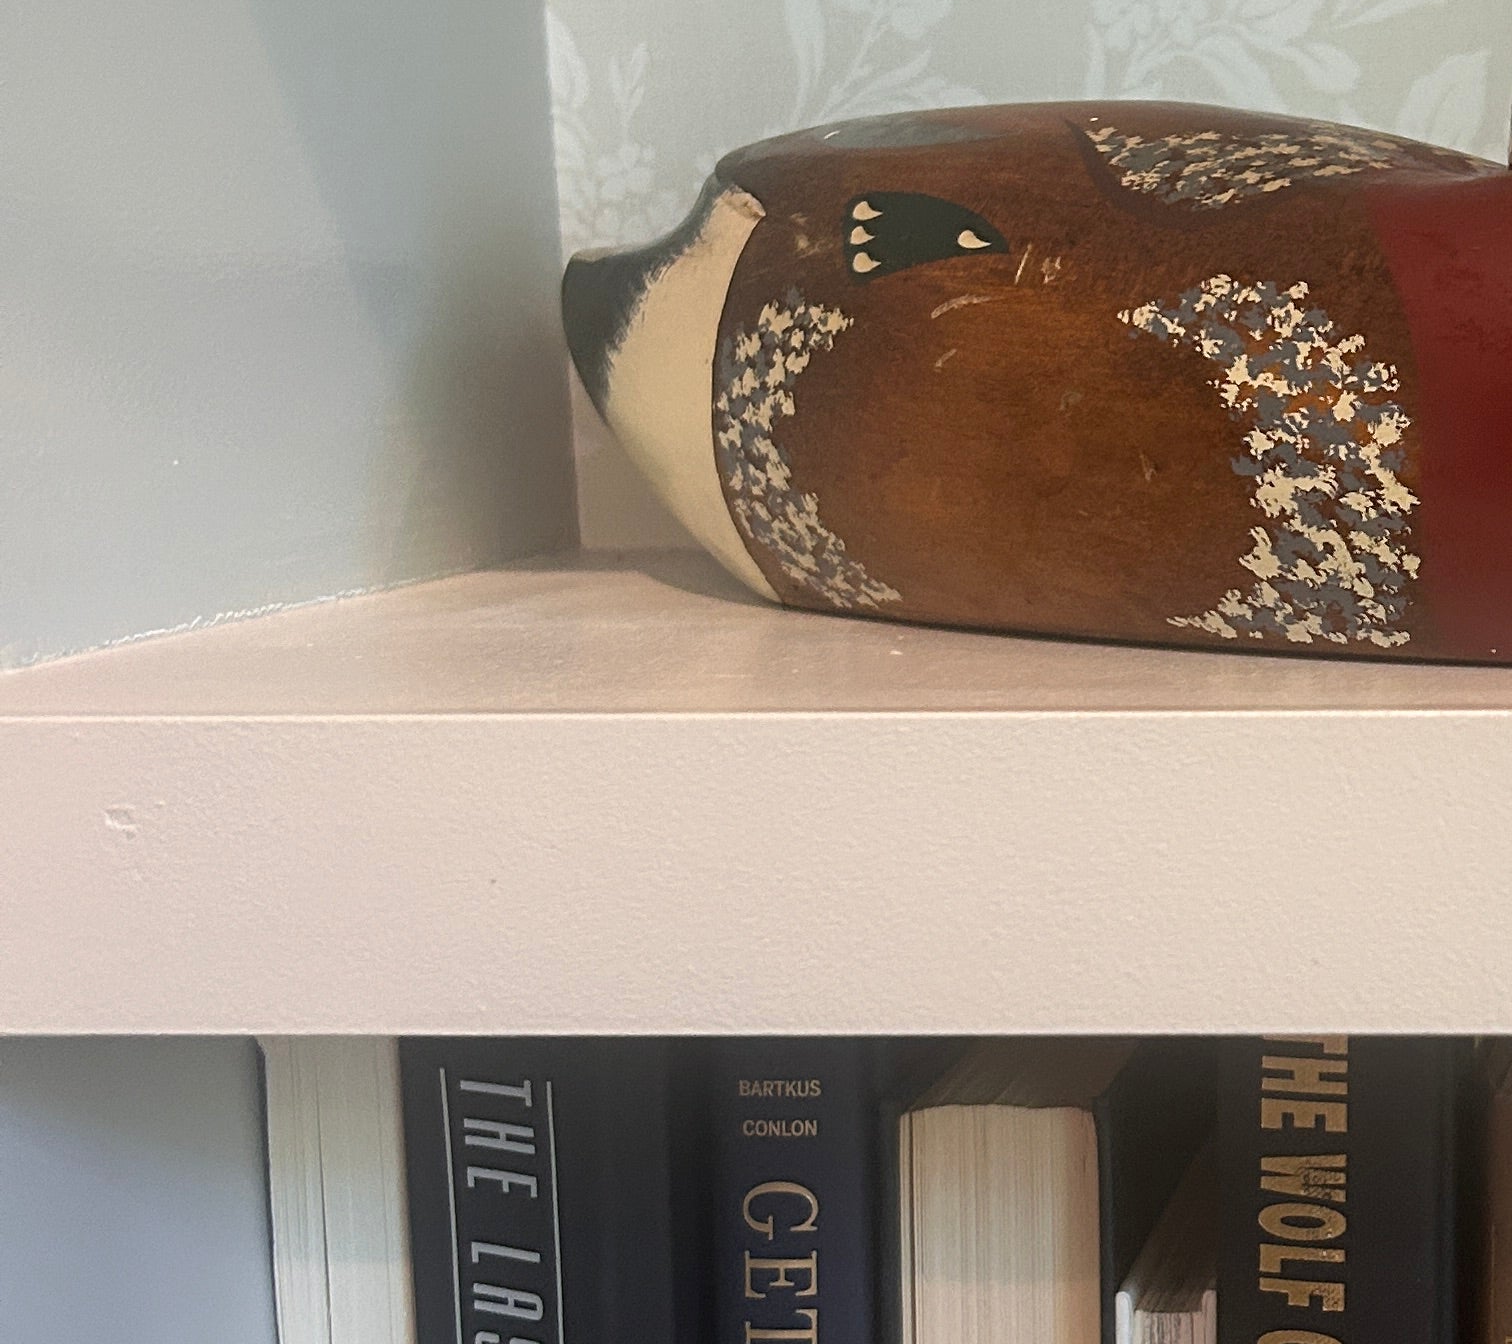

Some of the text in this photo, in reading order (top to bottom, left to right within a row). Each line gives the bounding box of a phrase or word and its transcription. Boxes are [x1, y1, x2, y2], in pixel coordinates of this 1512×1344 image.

[738, 1079, 822, 1098] BARTKUS
[459, 1079, 538, 1199] THE
[742, 1119, 819, 1138] CONLON
[1257, 1154, 1348, 1312] WOLF
